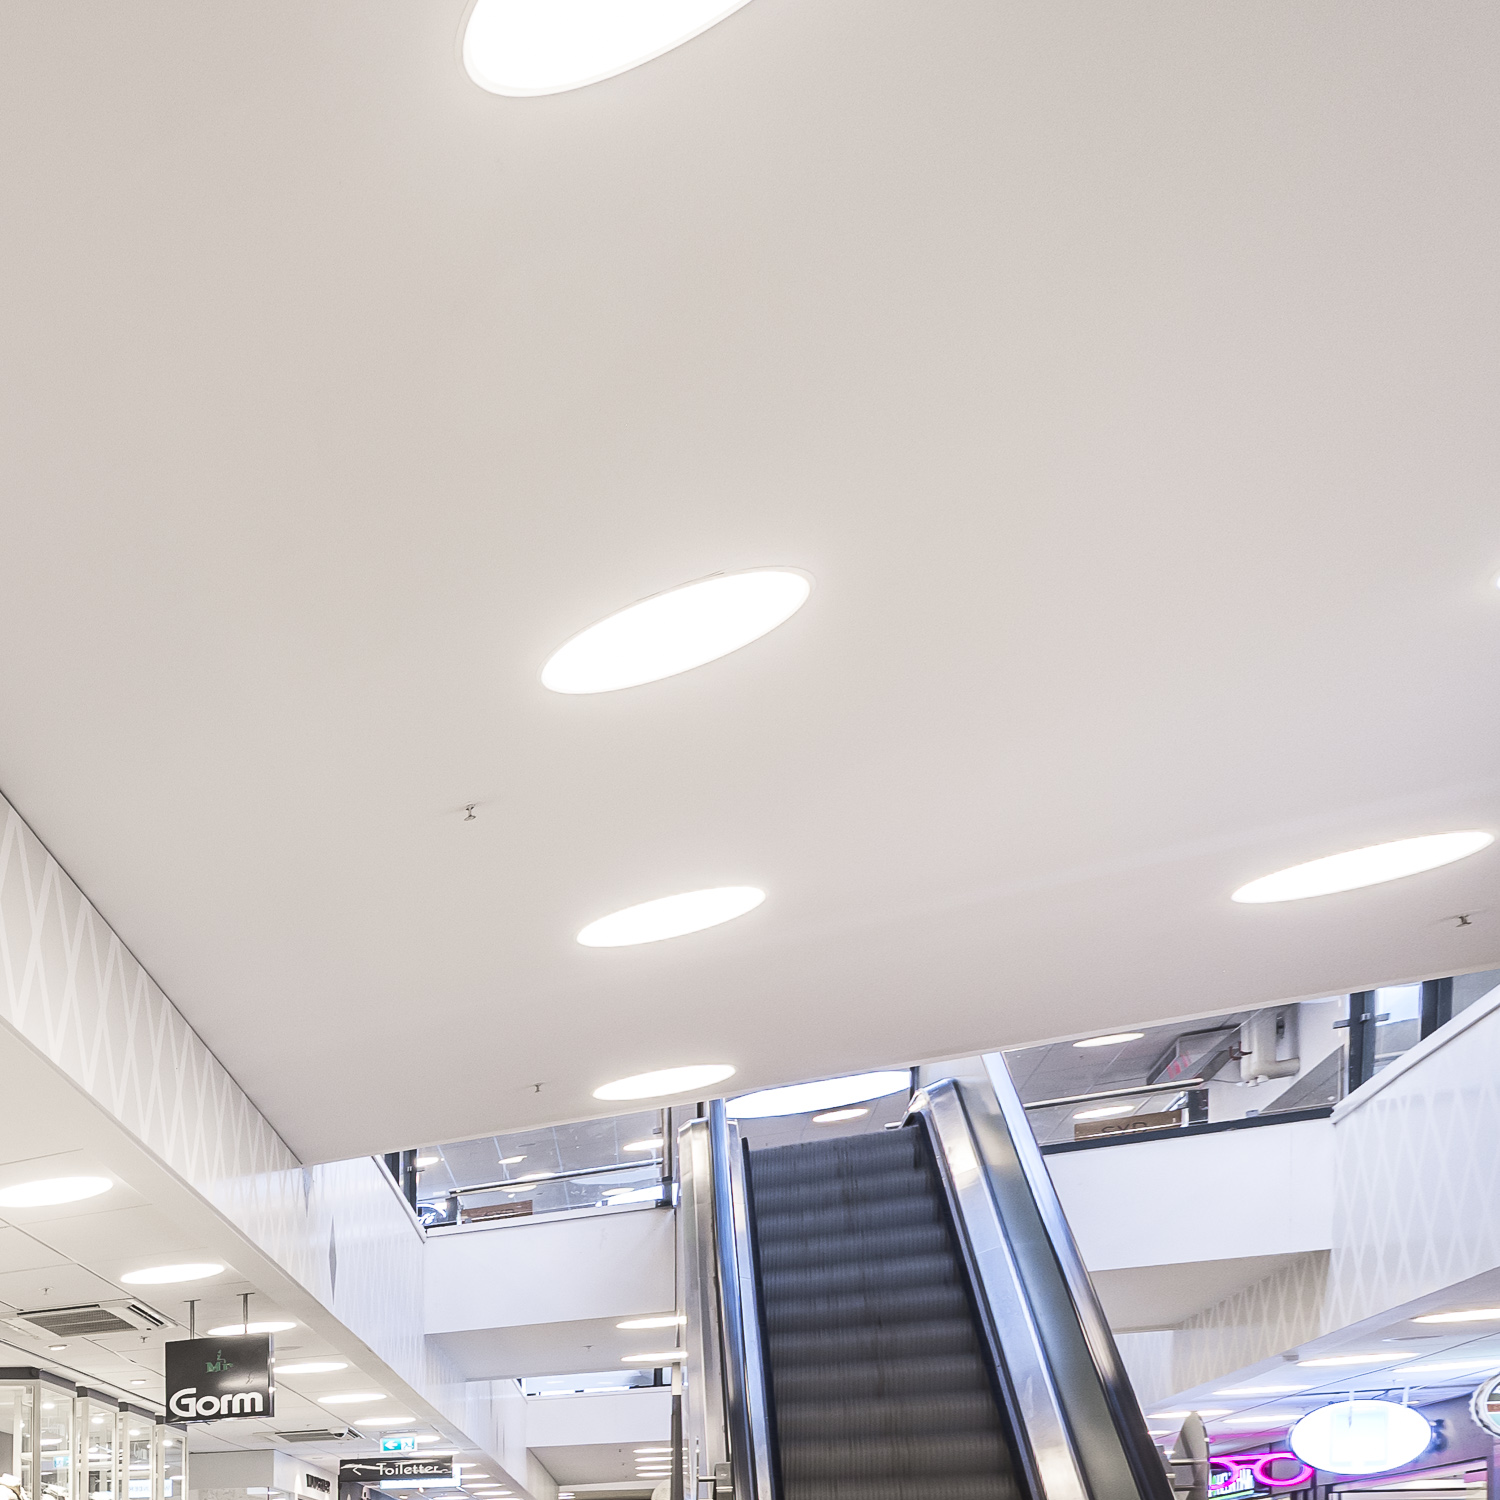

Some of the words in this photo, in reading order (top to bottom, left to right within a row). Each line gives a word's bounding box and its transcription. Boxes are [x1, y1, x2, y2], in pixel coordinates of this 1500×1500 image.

[205, 1360, 234, 1373] Mr
[169, 1387, 264, 1418] Gorm
[376, 1462, 440, 1476] Toiletter
